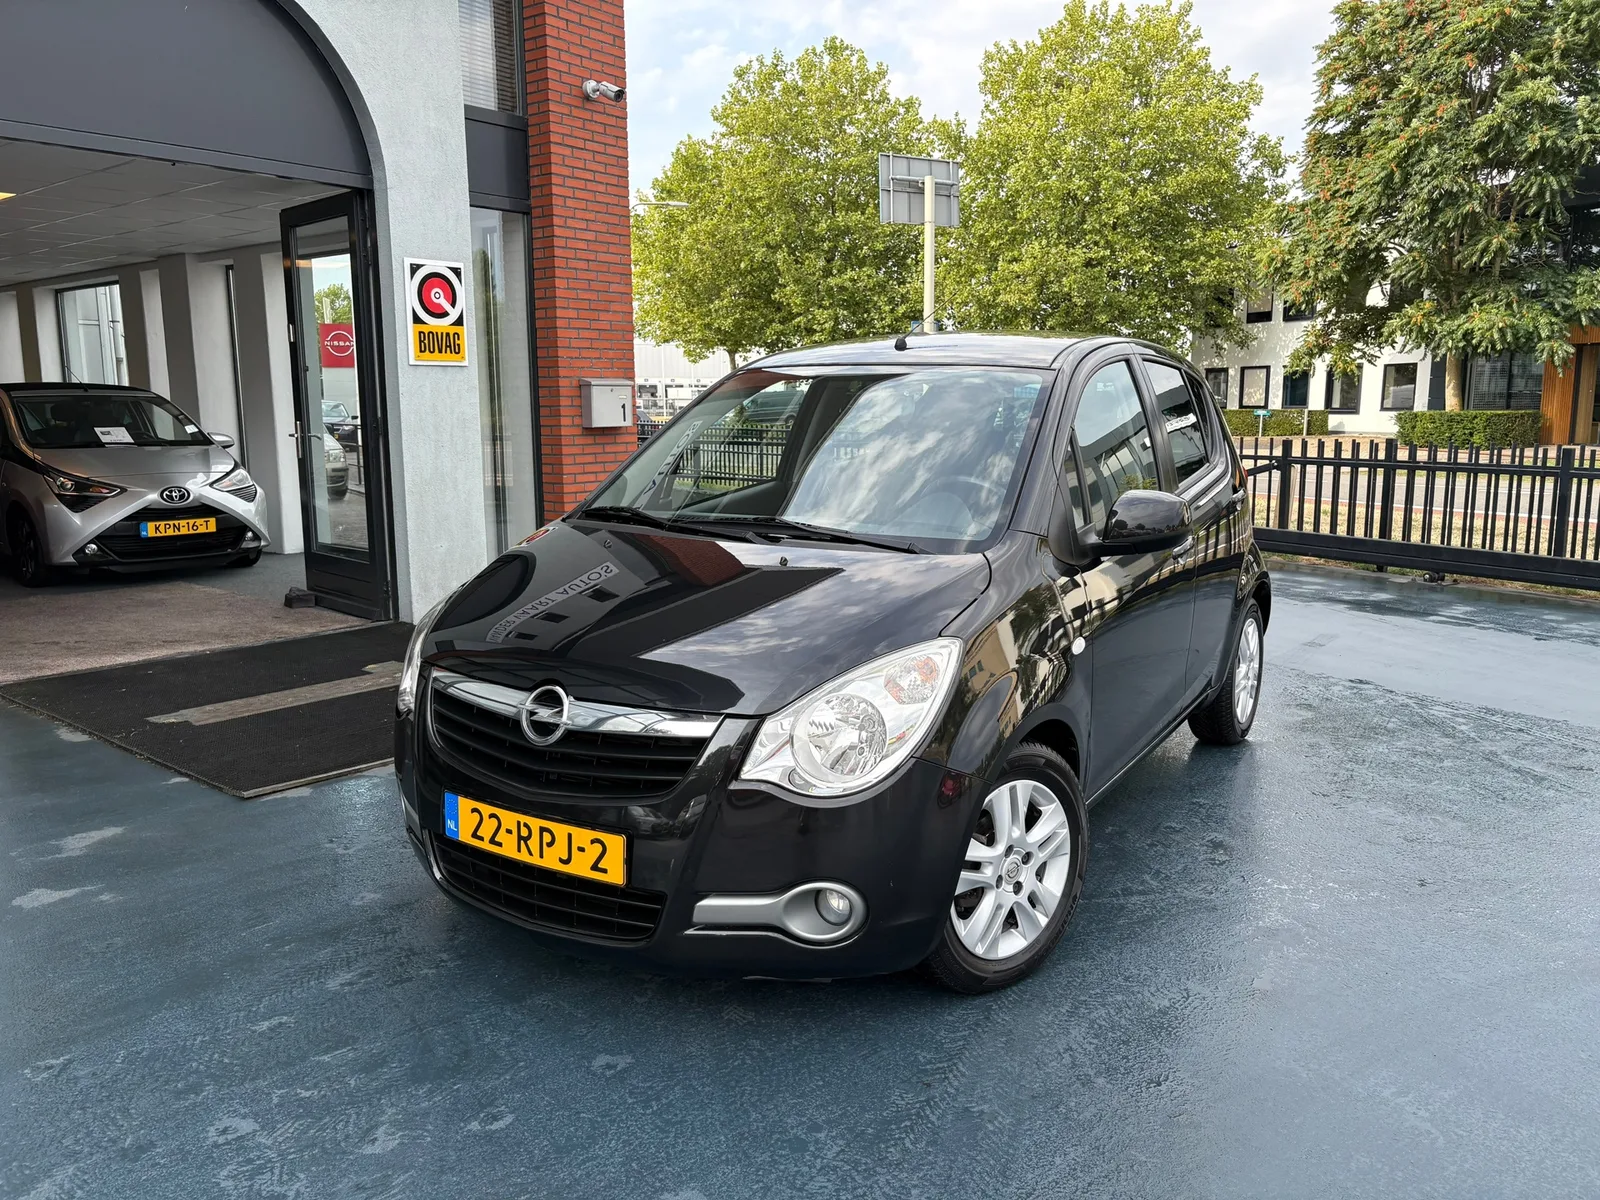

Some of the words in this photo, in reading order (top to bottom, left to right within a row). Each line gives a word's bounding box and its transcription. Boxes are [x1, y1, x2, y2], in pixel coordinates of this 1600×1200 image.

[418, 331, 461, 354] BOVAG
[621, 403, 626, 422] 1
[155, 520, 210, 534] KPN-16-T
[447, 819, 458, 831] NL
[470, 807, 609, 875] 22-RPJ-2
